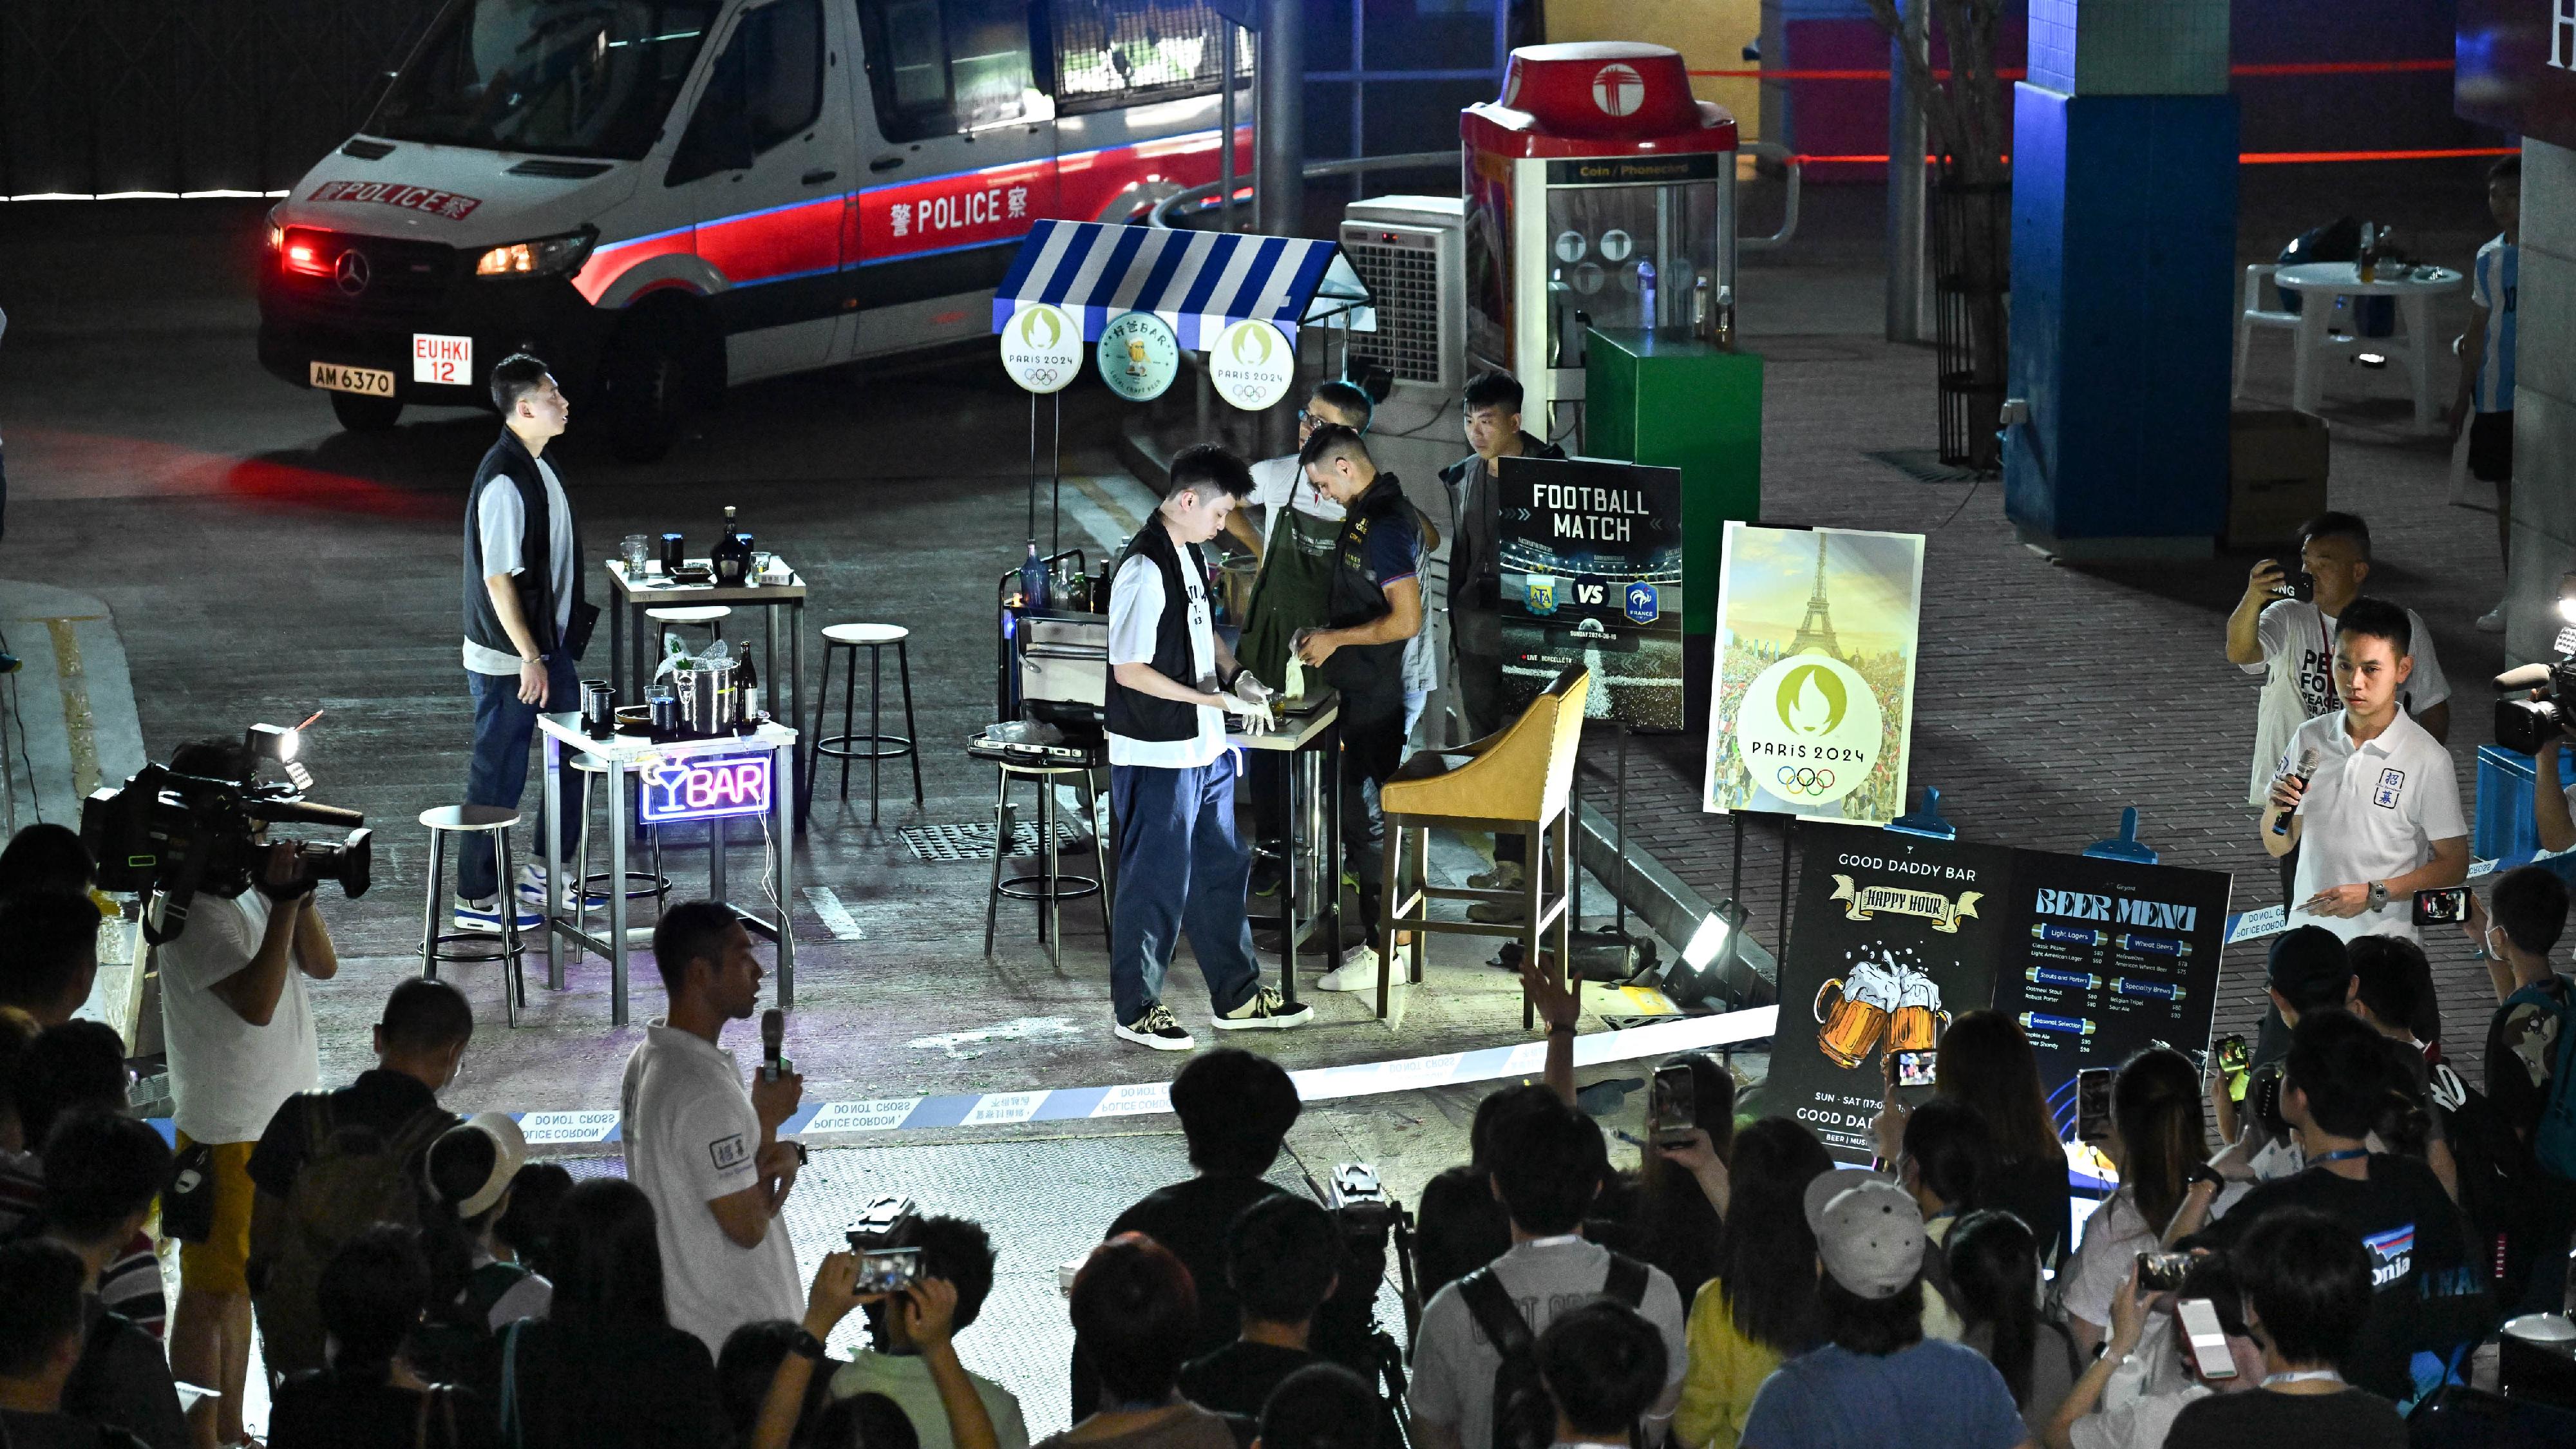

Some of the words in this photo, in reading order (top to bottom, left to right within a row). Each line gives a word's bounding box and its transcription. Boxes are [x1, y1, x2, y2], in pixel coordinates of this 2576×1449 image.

[1580, 166, 1609, 176] Coin
[336, 184, 450, 211] POLICE
[891, 204, 911, 236] 警
[918, 189, 1001, 233] POLICE
[1008, 185, 1028, 218] 察
[1010, 354, 1041, 365] PARIS
[1044, 355, 1073, 366] 2024
[316, 366, 337, 386] AM
[341, 370, 389, 392] 6370
[431, 361, 455, 382] 12
[1218, 370, 1249, 381] PARIS
[1253, 372, 1283, 383] 2024
[1533, 484, 1649, 515] FOOTBALL
[1554, 513, 1631, 542] MATCH
[1578, 584, 1604, 604] VS
[1752, 741, 1806, 759] PARIS
[1814, 746, 1864, 763] 2024
[687, 765, 762, 808] BAR
[1839, 853, 1882, 869] GOOD
[1888, 860, 1941, 876] DADDY
[1946, 867, 1976, 882] BAR
[1867, 889, 1906, 909] HAPPY
[1908, 895, 1942, 914] HOUR
[2036, 888, 2111, 921] BEER
[2116, 898, 2197, 931] MENU
[2135, 940, 2155, 948] Wheat
[2156, 942, 2174, 951] Beers
[2125, 983, 2152, 993] Specialty
[2033, 1017, 2057, 1025] Seasonal
[2058, 1020, 2081, 1028] Selection
[2040, 1041, 2059, 1050] Shandy
[1815, 1092, 1835, 1103] SUN
[1842, 1096, 1861, 1106] SAT
[1797, 1108, 1841, 1124] GOOD
[1826, 1133, 1844, 1142] BEER
